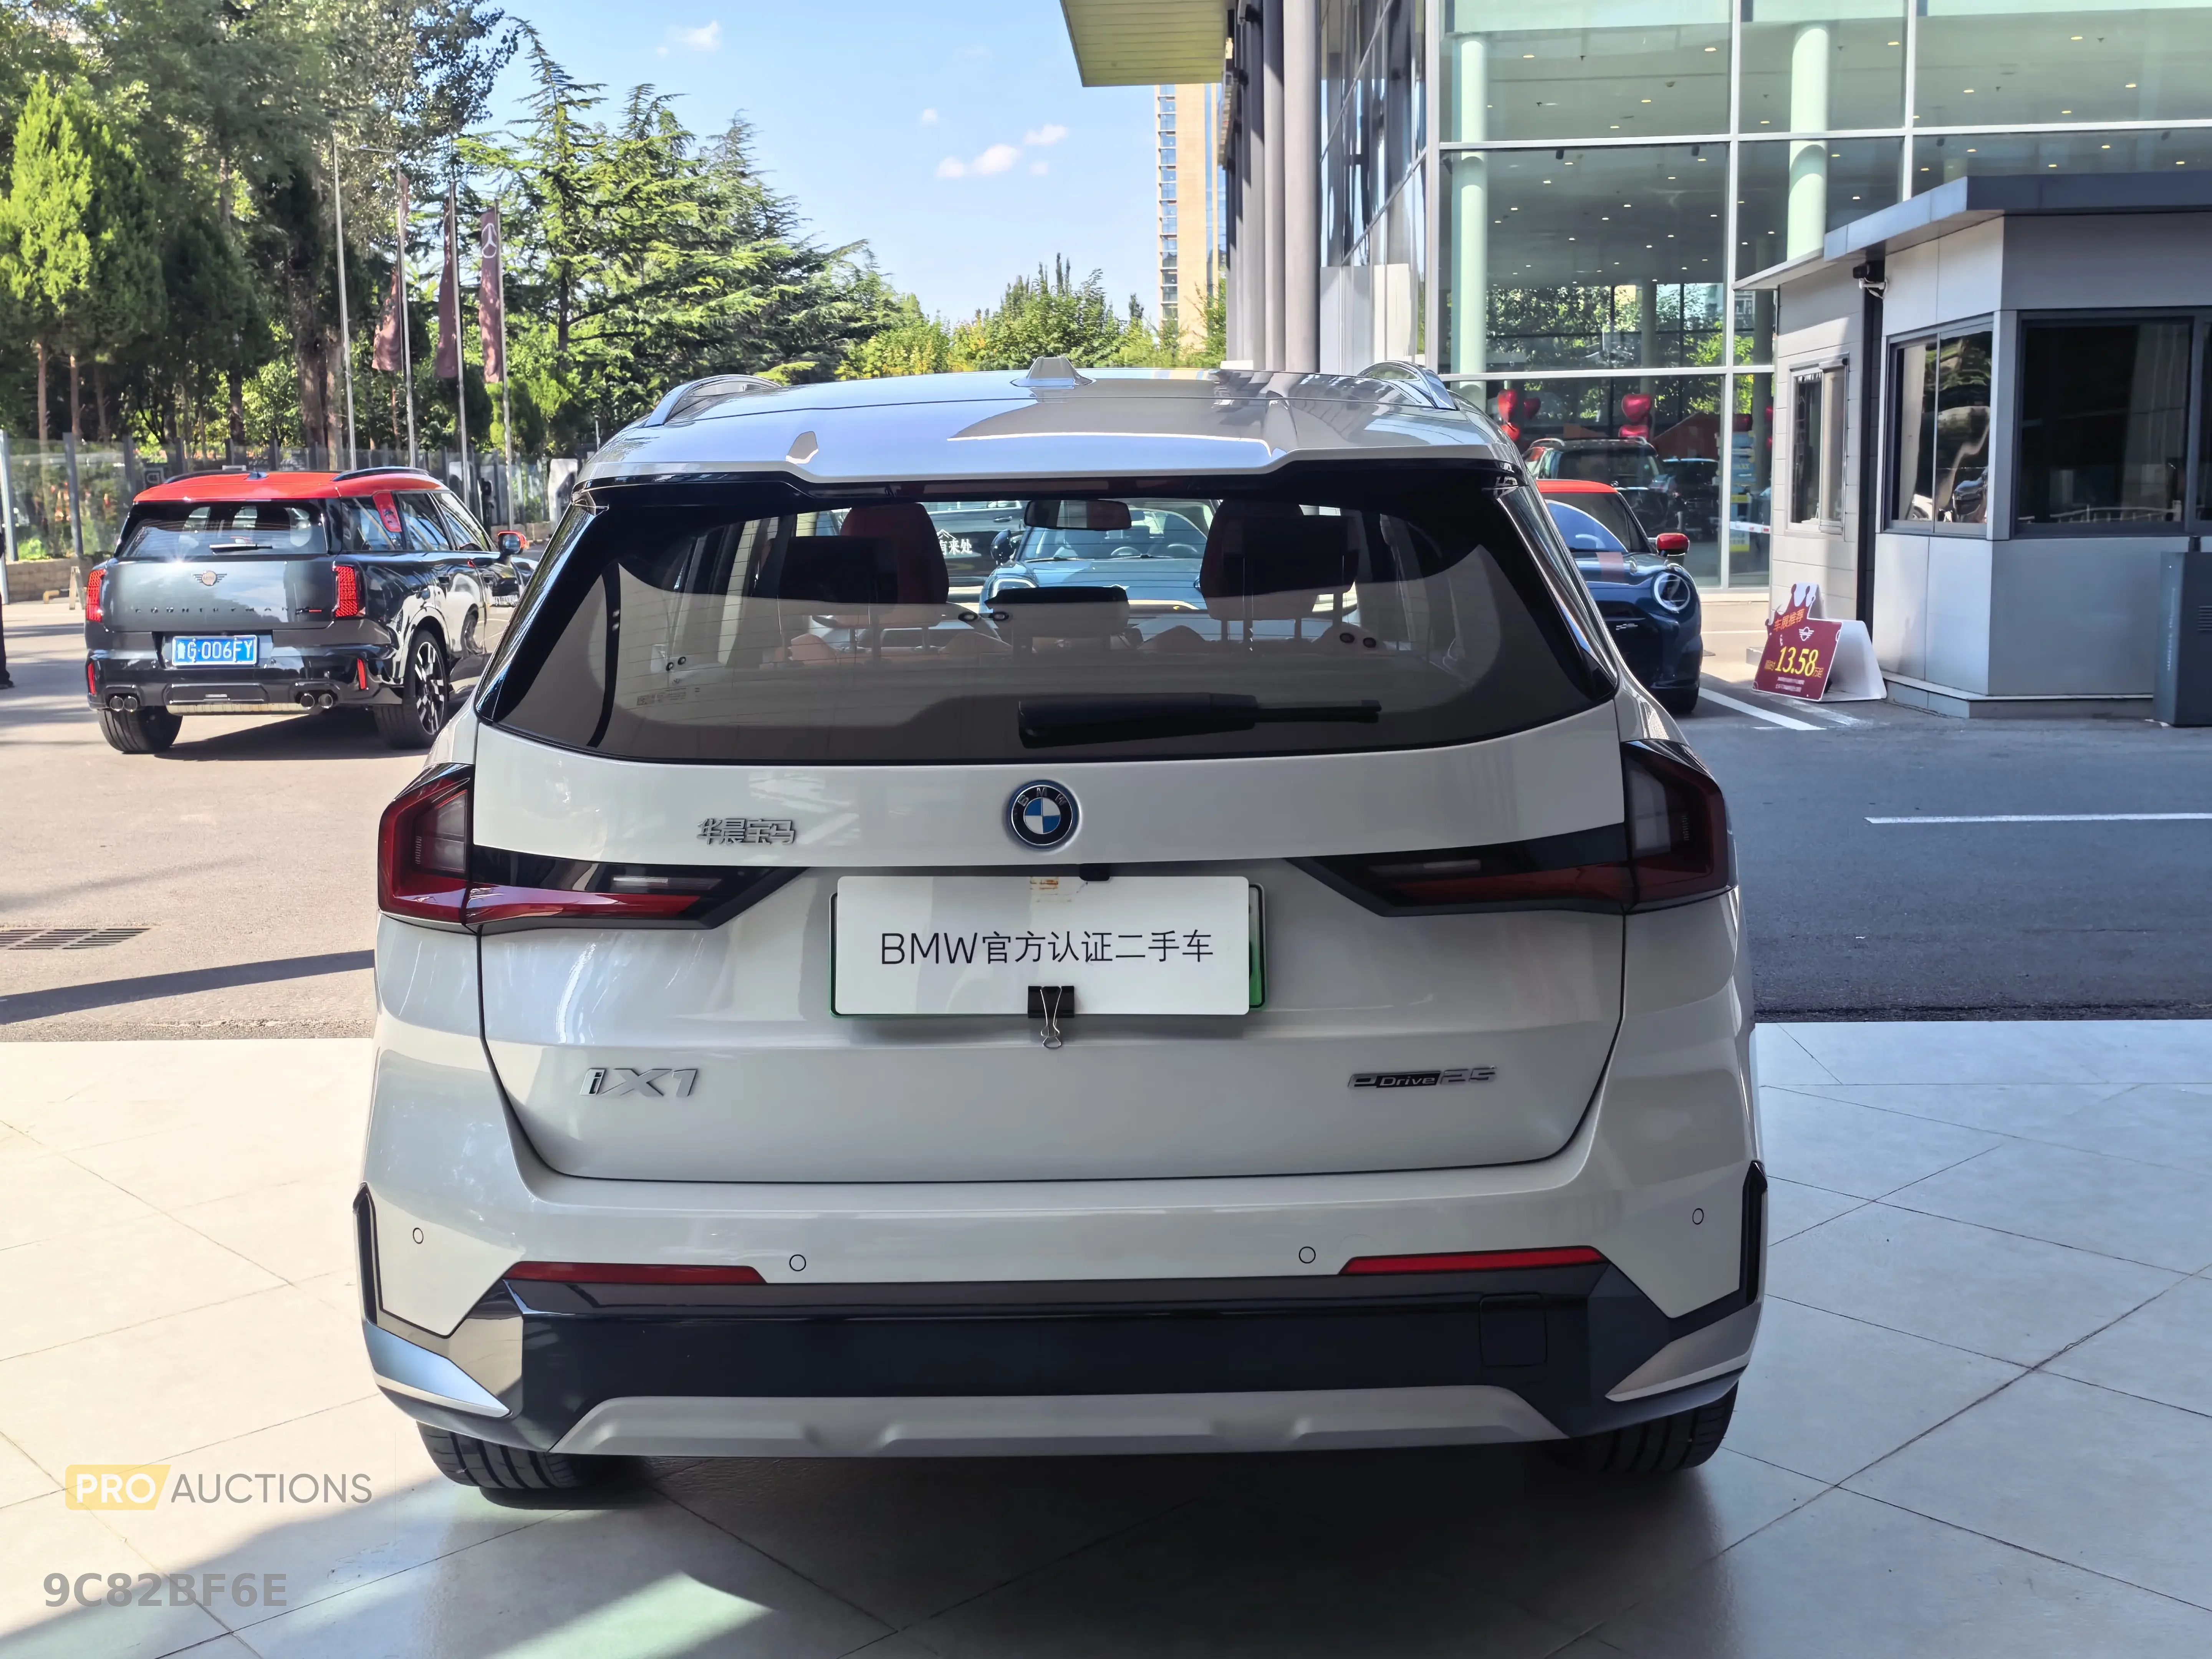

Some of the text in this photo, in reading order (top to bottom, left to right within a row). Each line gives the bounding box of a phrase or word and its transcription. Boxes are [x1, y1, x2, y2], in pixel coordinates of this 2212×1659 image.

[177, 641, 253, 661] G·006FY
[1775, 646, 1819, 676] 13.58
[1018, 787, 1067, 806] BMW
[696, 818, 796, 845] 华晨宝马
[881, 930, 1214, 965] BMW官方认证二手车
[579, 1068, 699, 1097] iX1
